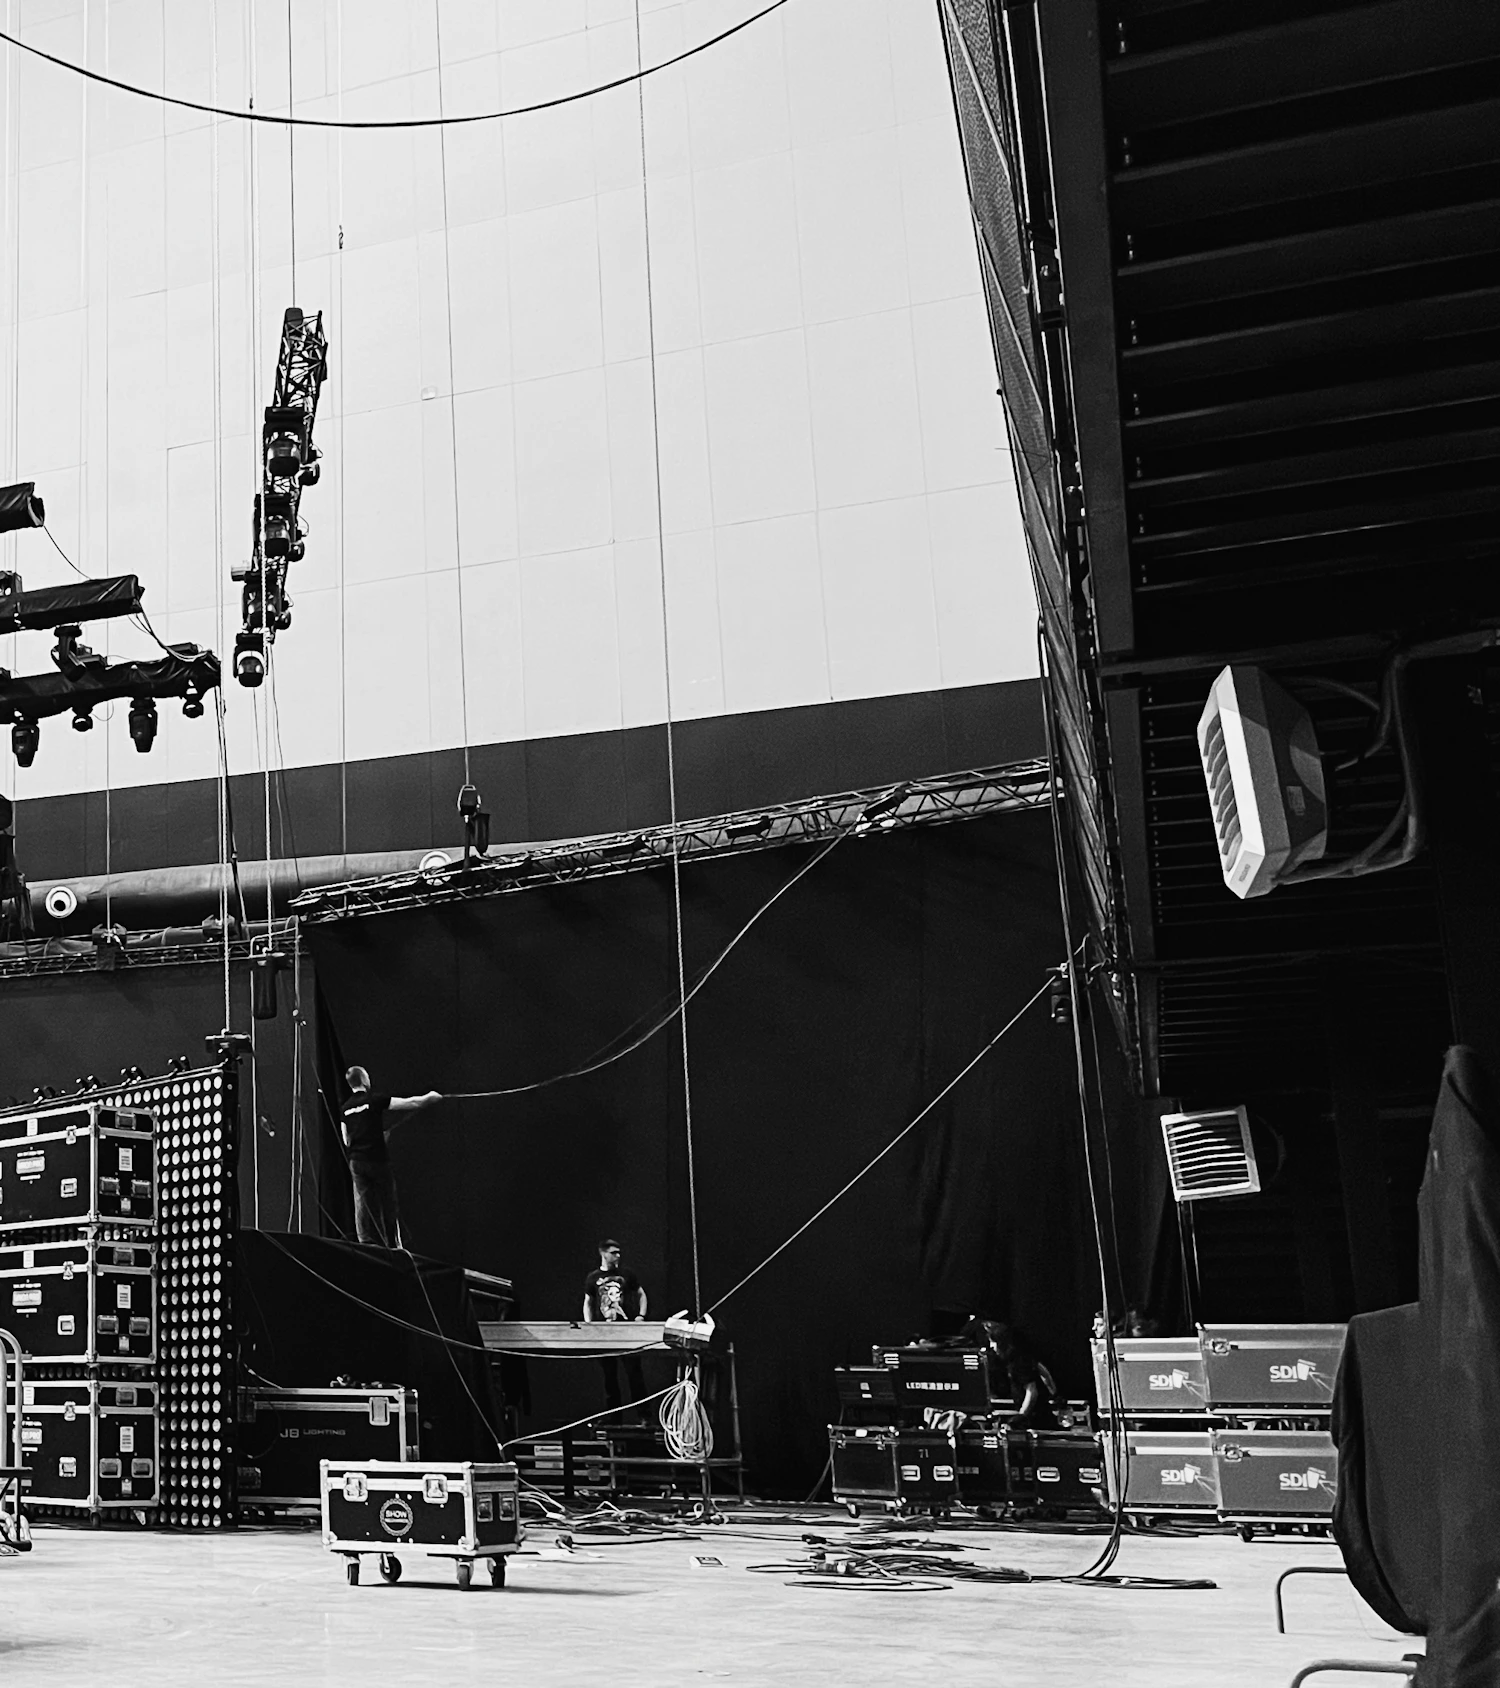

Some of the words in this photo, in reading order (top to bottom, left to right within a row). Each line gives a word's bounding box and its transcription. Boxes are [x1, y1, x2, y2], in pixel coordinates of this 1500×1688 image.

[1269, 1365, 1298, 1379] SDI
[1149, 1374, 1173, 1387] SDI
[279, 1428, 300, 1439] JB
[302, 1428, 346, 1436] LIGHTING
[1160, 1469, 1185, 1482] SDI
[1279, 1472, 1308, 1488] SDI
[385, 1510, 407, 1518] SHOW
